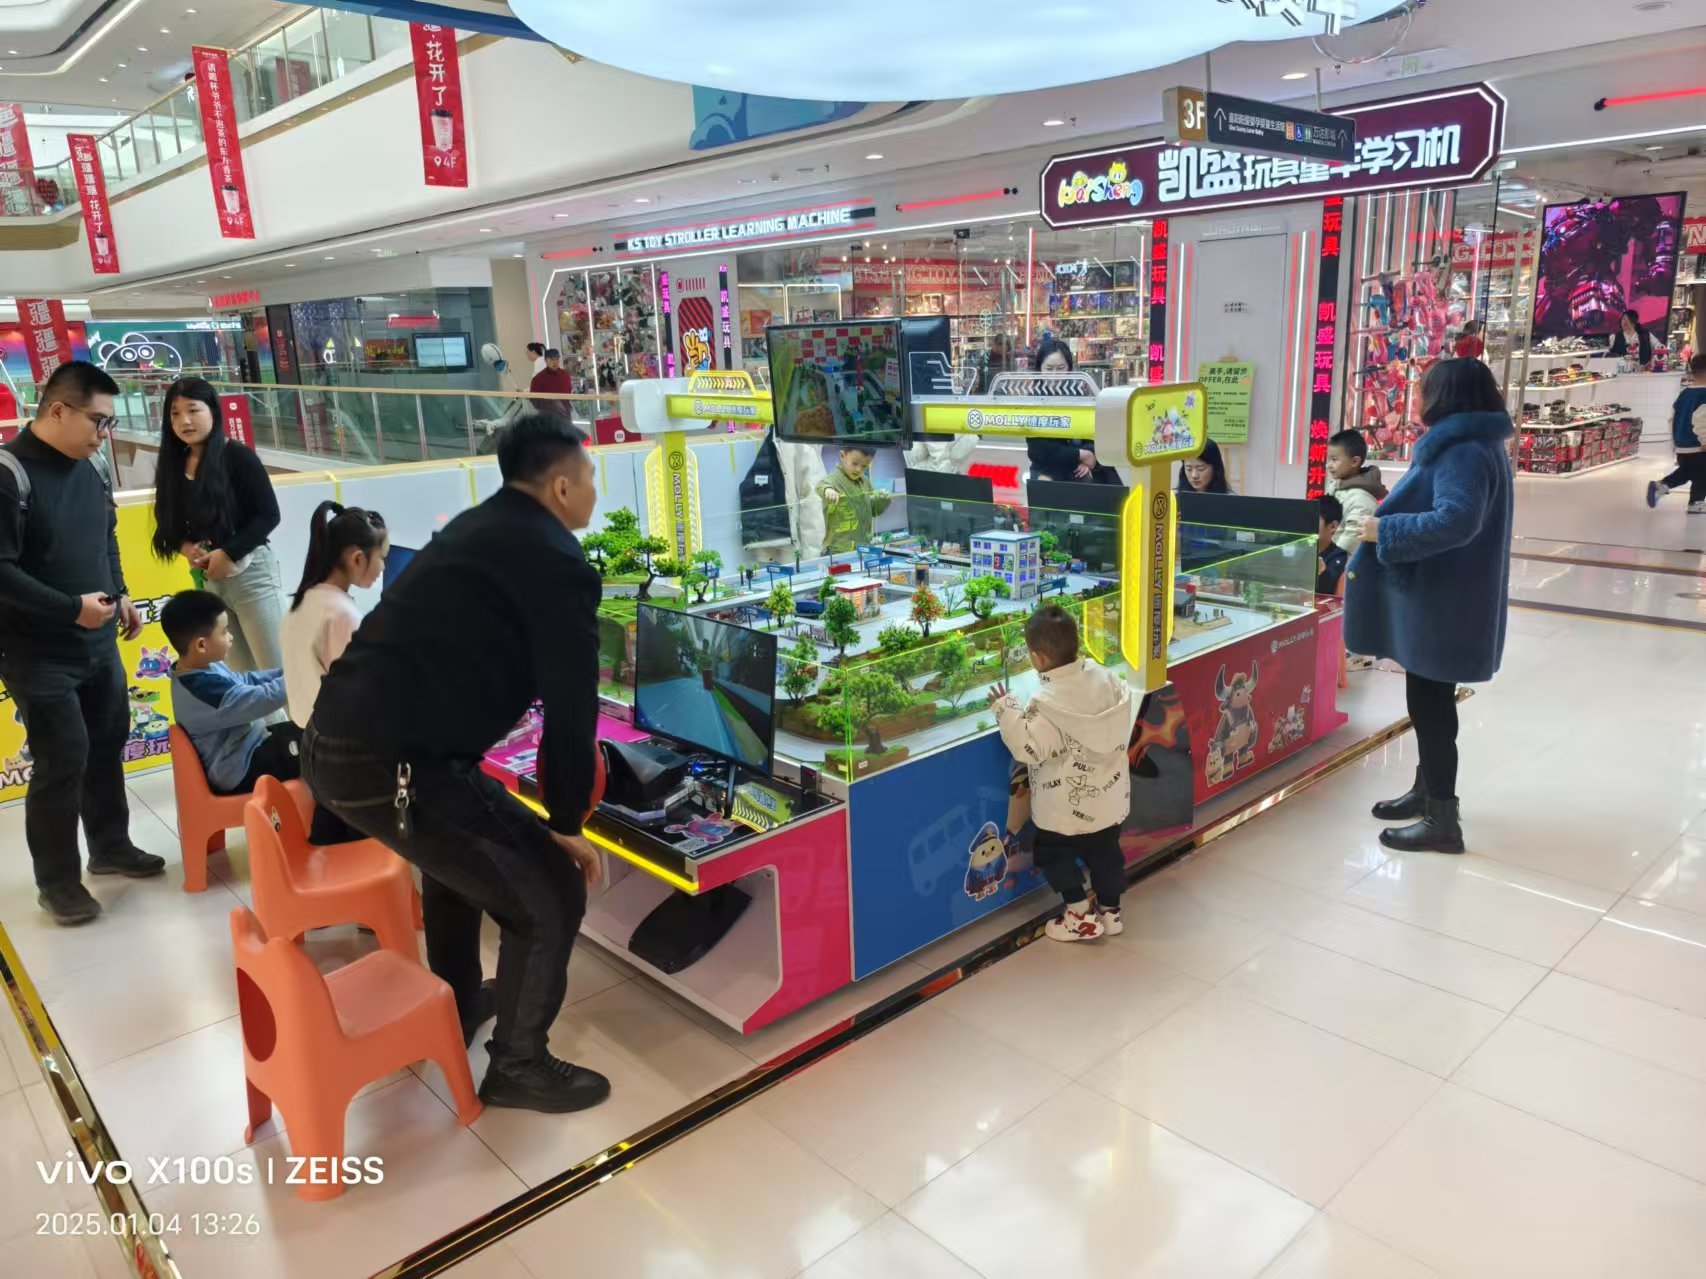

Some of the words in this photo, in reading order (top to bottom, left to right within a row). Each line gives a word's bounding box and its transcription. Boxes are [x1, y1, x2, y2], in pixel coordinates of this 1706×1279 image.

[1183, 98, 1206, 130] 3F
[664, 229, 721, 248] STROLLER
[721, 217, 784, 241] LEARNING
[786, 207, 851, 231] MACHINE
[1152, 220, 1168, 304] 凯盛玩具
[1313, 303, 1337, 393] 凯盛玩具
[984, 414, 1026, 428] MOLLY
[673, 472, 684, 519] MOLLY
[1154, 523, 1163, 590] MOLLY
